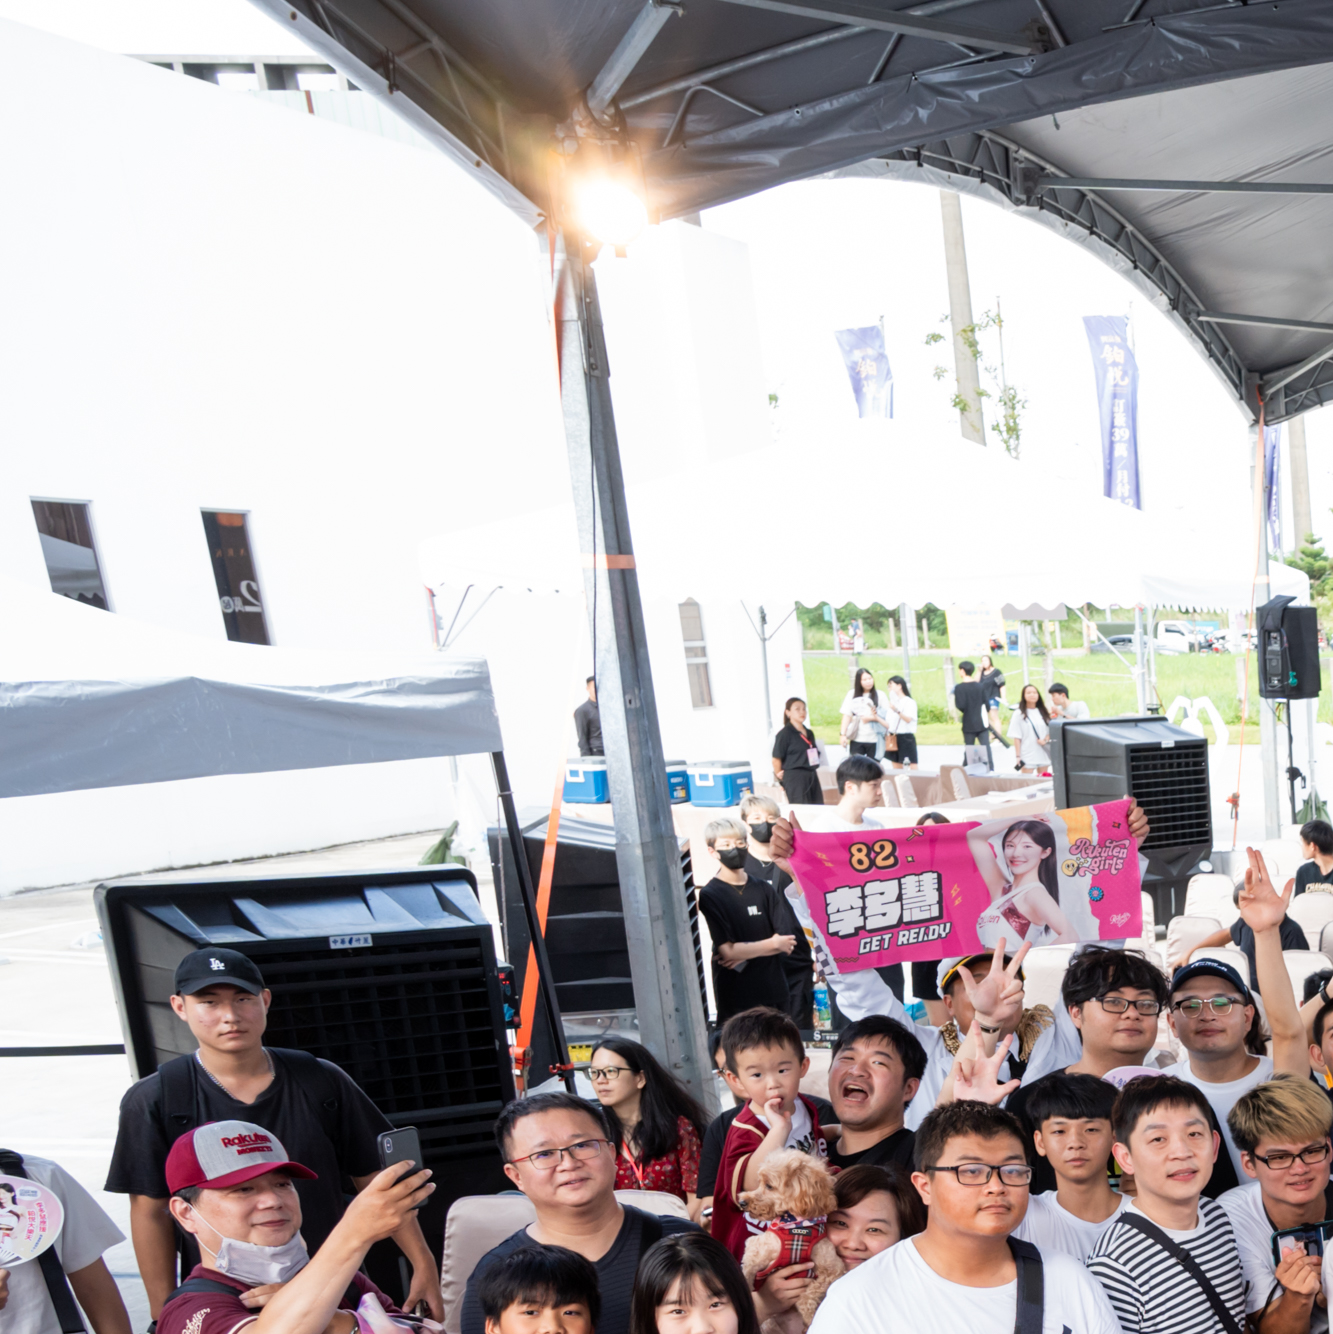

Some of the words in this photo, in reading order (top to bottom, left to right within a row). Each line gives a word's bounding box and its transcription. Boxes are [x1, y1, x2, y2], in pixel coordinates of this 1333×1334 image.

[849, 840, 899, 873] 82
[1069, 838, 1130, 859] Rakuten
[1078, 857, 1124, 877] girls
[825, 872, 943, 938] 李多慧
[859, 932, 892, 956] GET
[898, 922, 952, 948] READY
